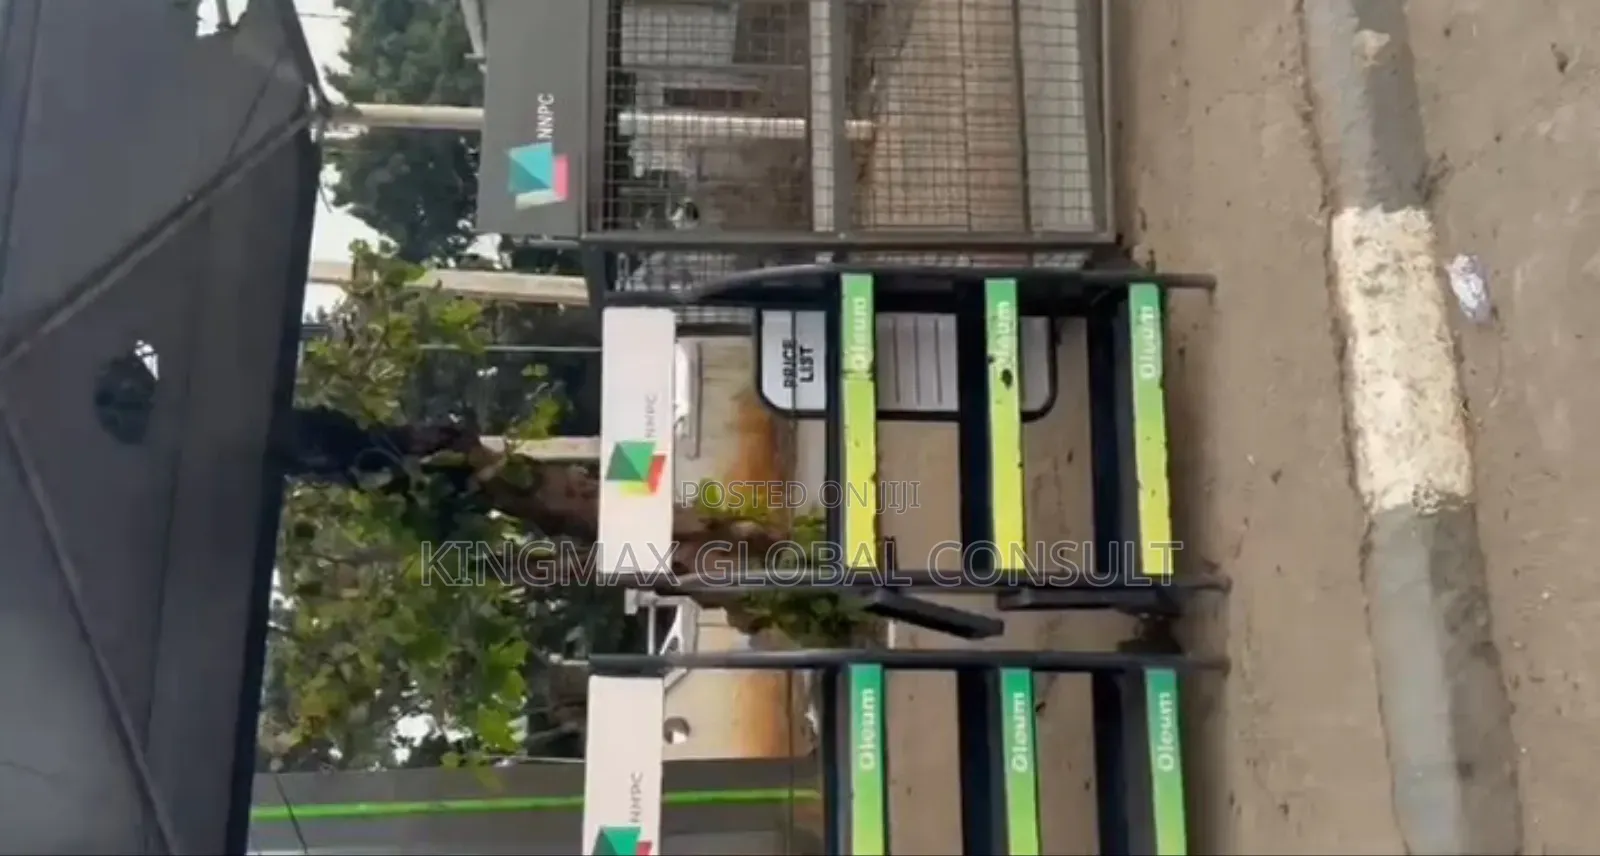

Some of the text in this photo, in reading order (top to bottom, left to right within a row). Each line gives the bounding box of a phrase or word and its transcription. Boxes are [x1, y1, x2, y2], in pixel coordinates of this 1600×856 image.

[536, 93, 554, 139] NNPC
[782, 339, 797, 388] PRICE
[799, 345, 814, 383] LIST
[859, 687, 876, 771] Oleum
[1011, 691, 1029, 772] Oleum
[1157, 691, 1175, 772] Oleum
